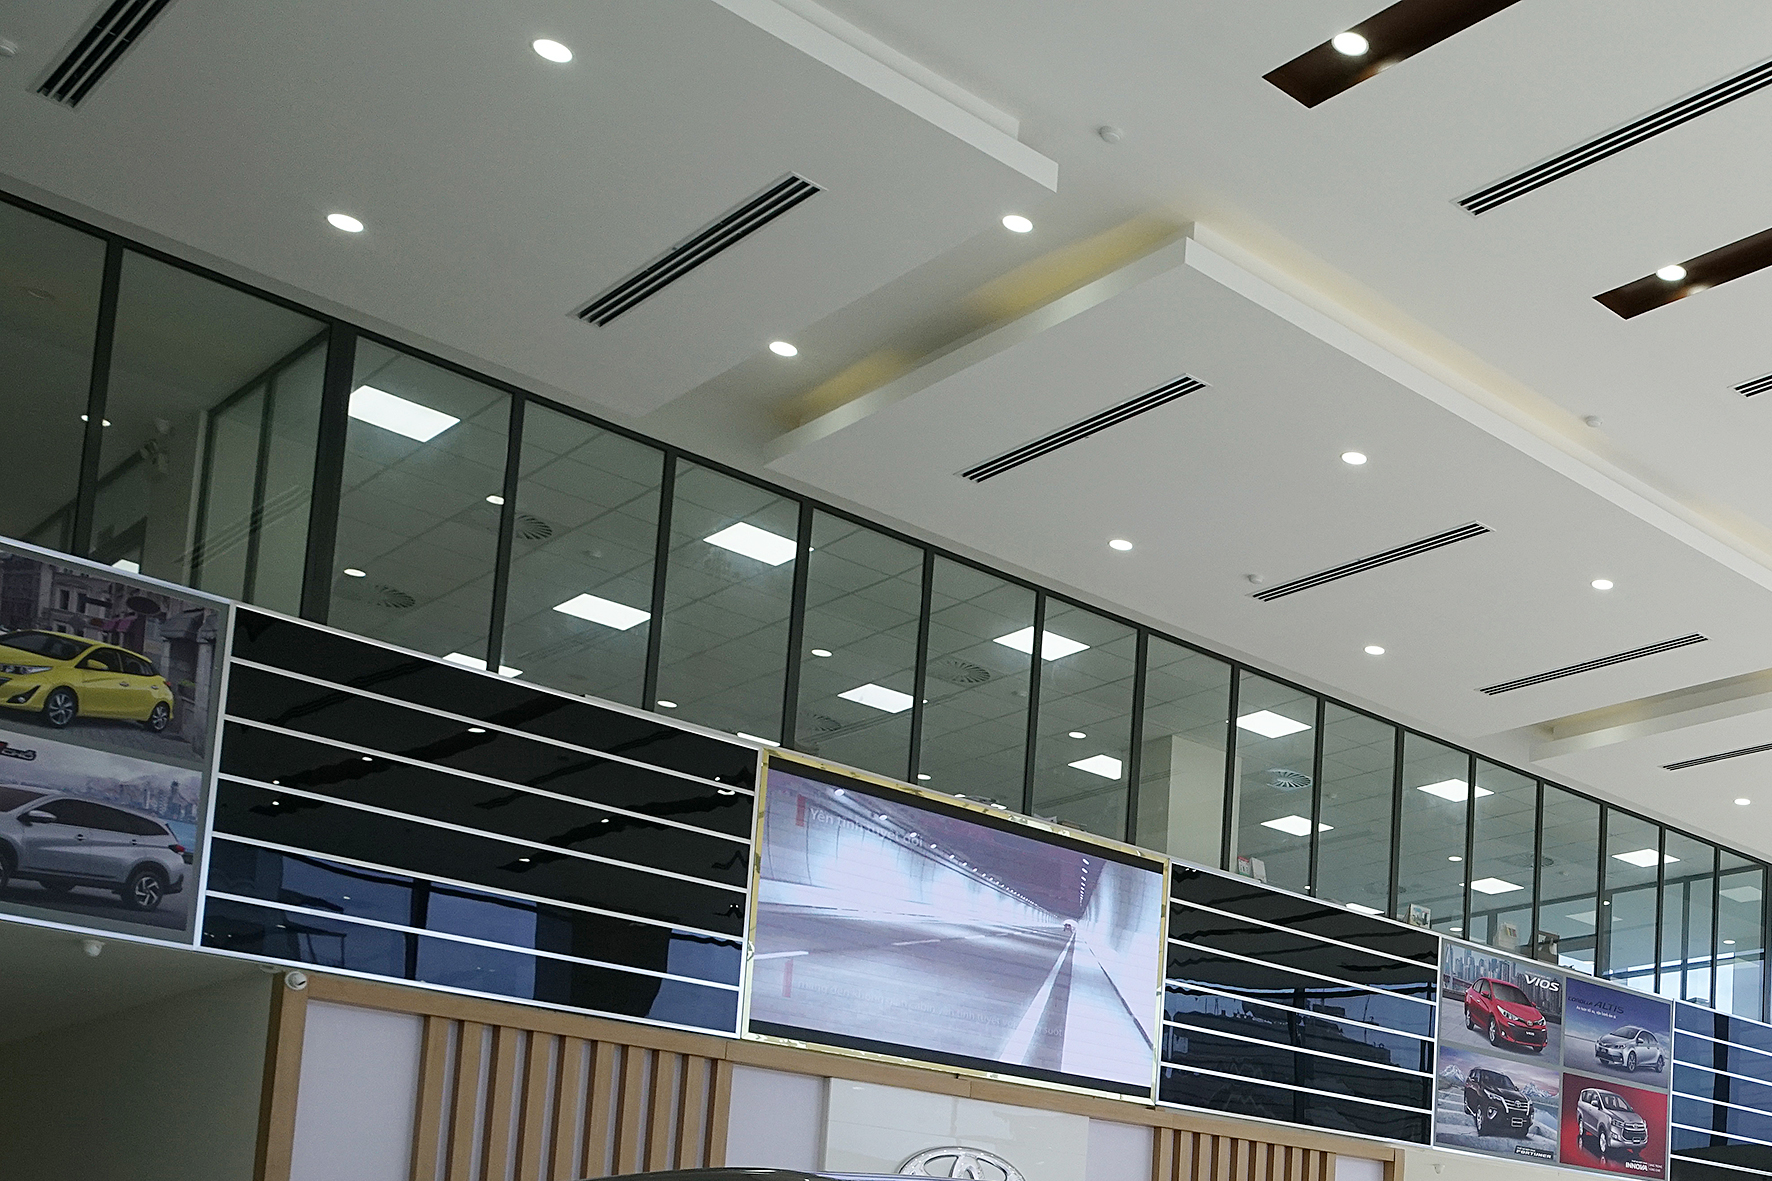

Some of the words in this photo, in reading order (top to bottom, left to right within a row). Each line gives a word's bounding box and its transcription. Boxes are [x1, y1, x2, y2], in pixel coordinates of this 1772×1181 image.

[1524, 974, 1560, 992] VIOS
[1593, 1001, 1625, 1014] ALTIS
[1625, 1161, 1648, 1172] INNOVA
